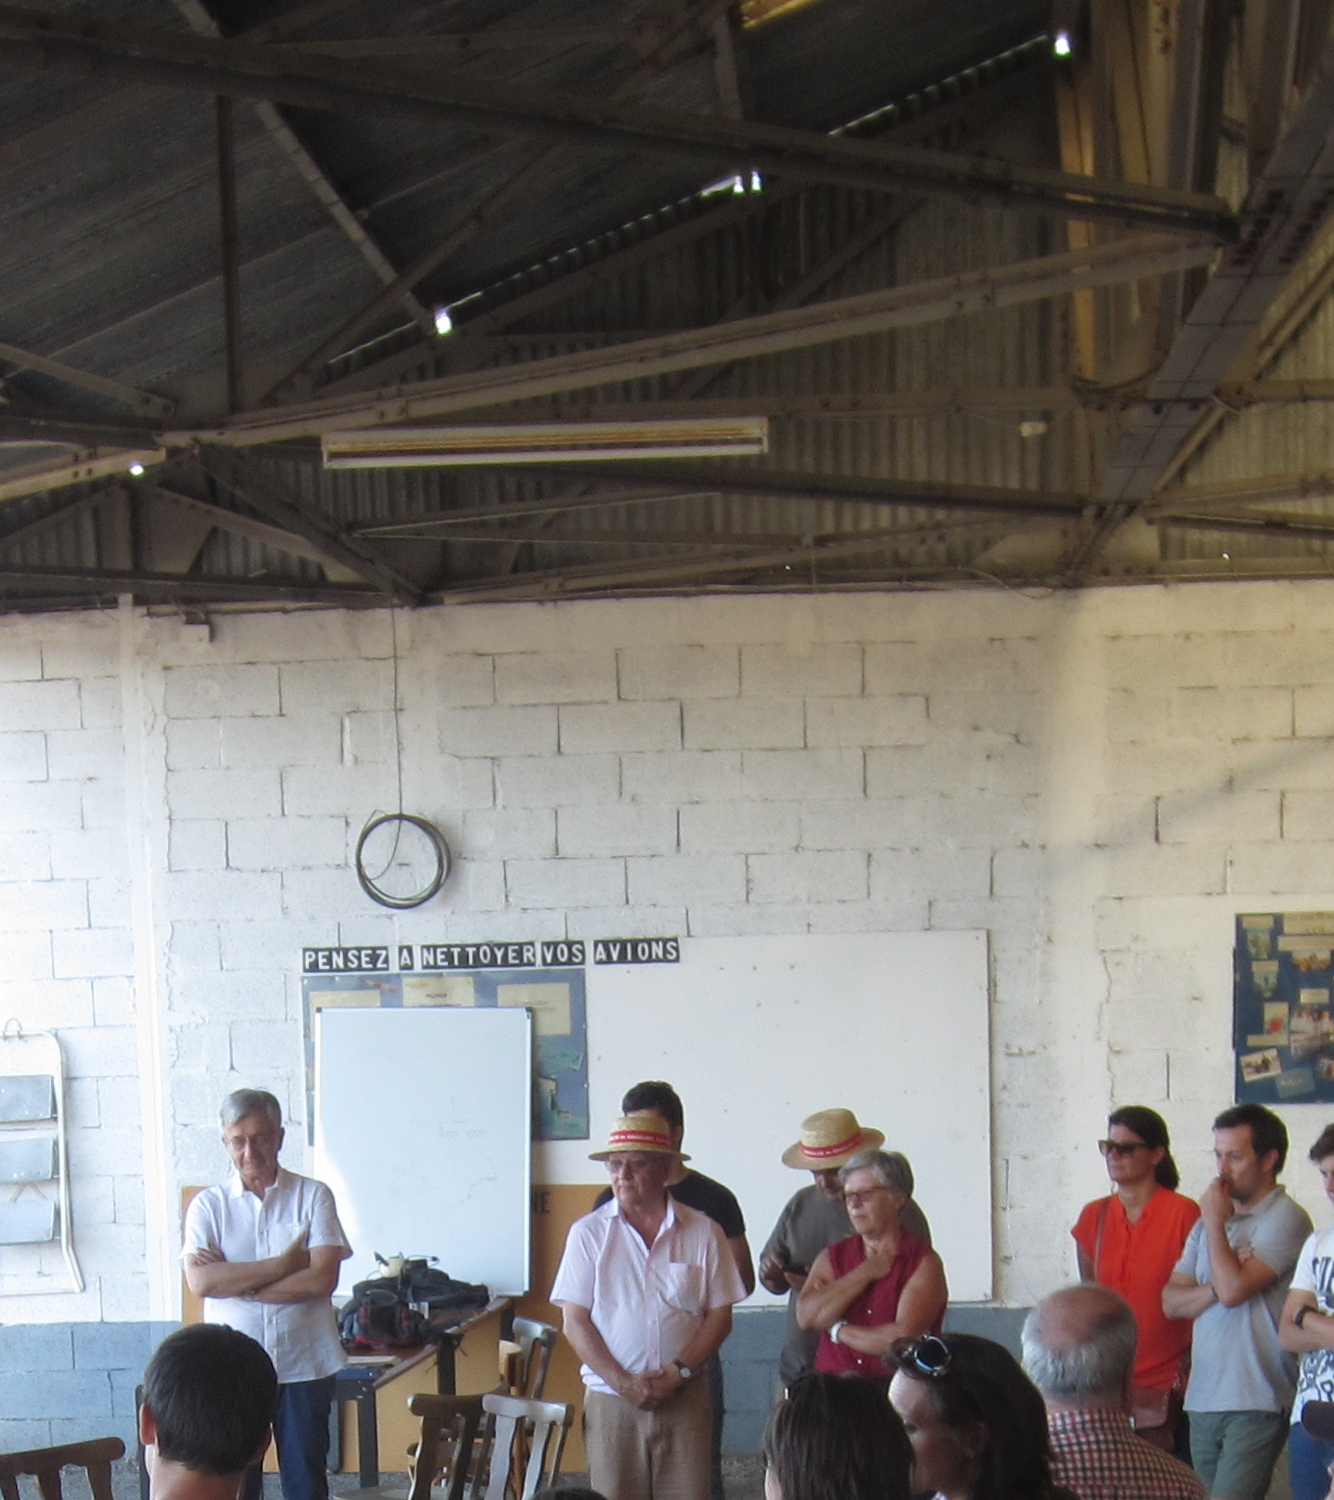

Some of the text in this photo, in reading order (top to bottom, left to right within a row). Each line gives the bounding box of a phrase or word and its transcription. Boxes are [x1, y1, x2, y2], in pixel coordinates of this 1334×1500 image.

[305, 941, 678, 969] PENSEZ A NETTOYER VOS AVIONS
